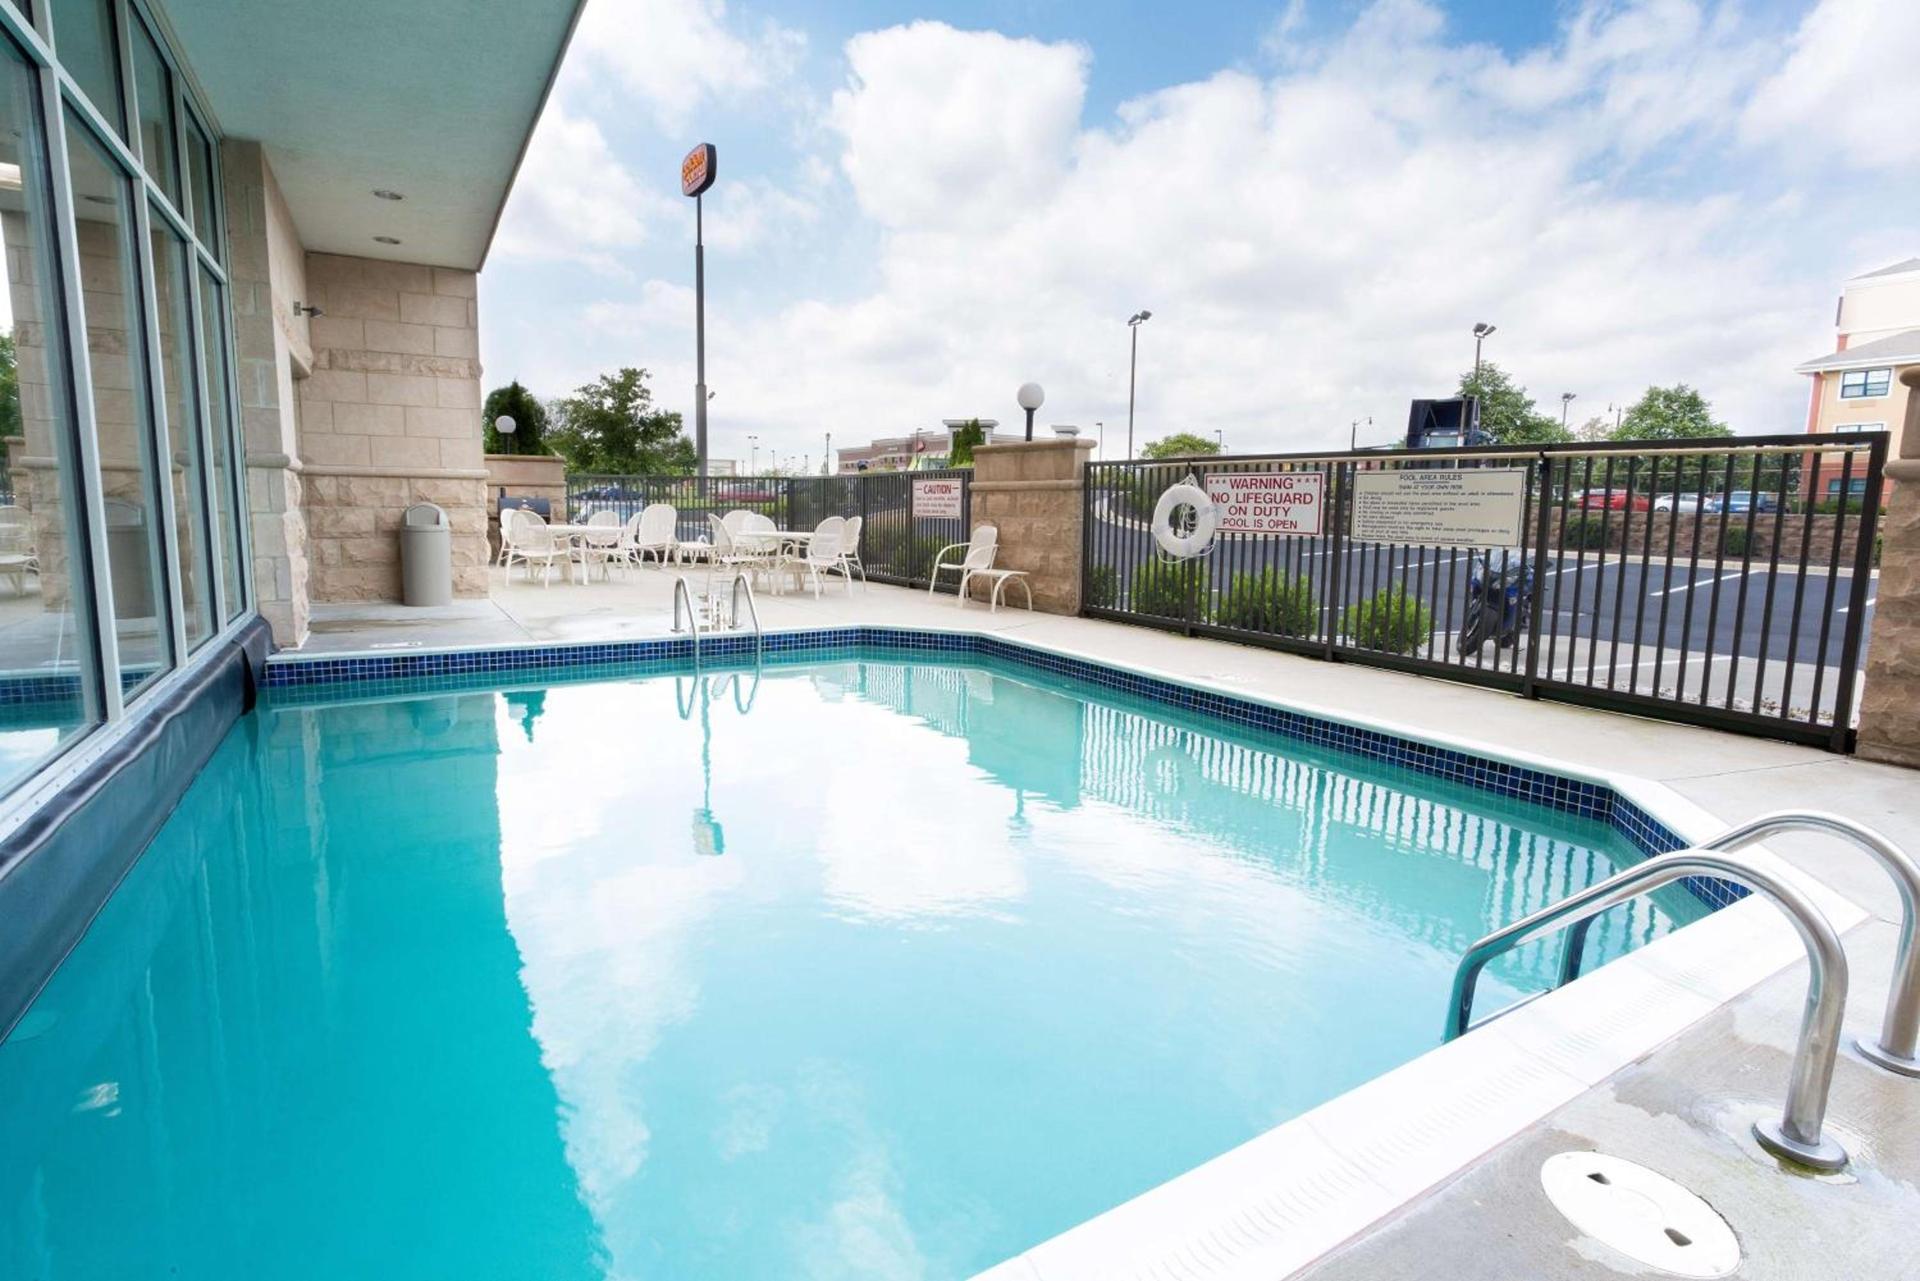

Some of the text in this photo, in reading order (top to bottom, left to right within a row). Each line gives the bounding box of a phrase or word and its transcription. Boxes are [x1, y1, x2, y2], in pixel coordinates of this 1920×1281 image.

[923, 484, 952, 495] CAUTION
[1229, 477, 1294, 490] WARNING
[1211, 492, 1313, 505] NO LIFEGUARD
[1228, 505, 1291, 517] ON DUTY
[1223, 518, 1298, 529] POOL IS OPEN
